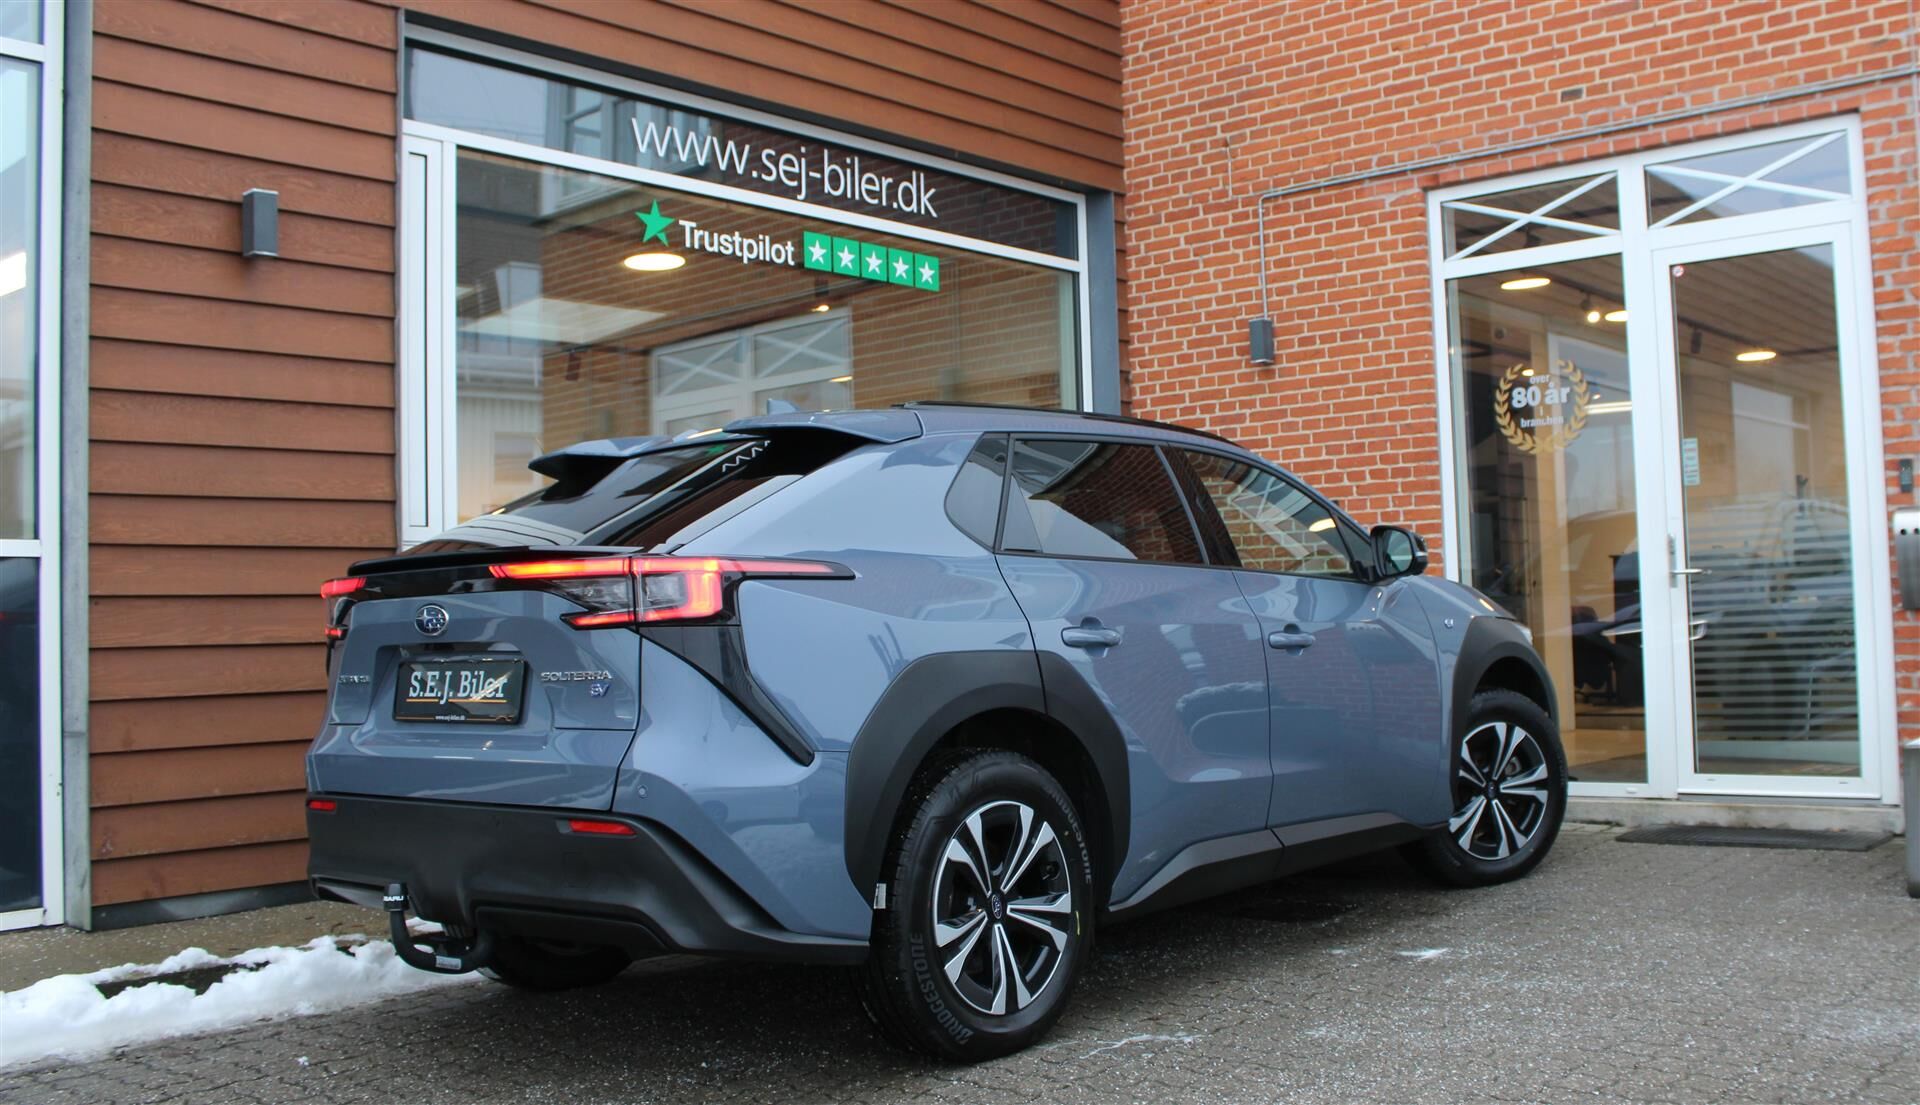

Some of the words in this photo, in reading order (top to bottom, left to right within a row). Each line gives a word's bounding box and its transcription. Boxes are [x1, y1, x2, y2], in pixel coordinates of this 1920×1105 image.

[632, 117, 938, 218] www.sej-biler.dk
[678, 219, 795, 267] Trustpilot
[1529, 374, 1551, 385] over
[1511, 385, 1541, 408] 80
[1545, 381, 1571, 405] år
[408, 670, 453, 705] S.E.J.
[457, 670, 508, 699] Biler
[540, 669, 613, 681] SOLTERRA
[590, 683, 611, 698] EV
